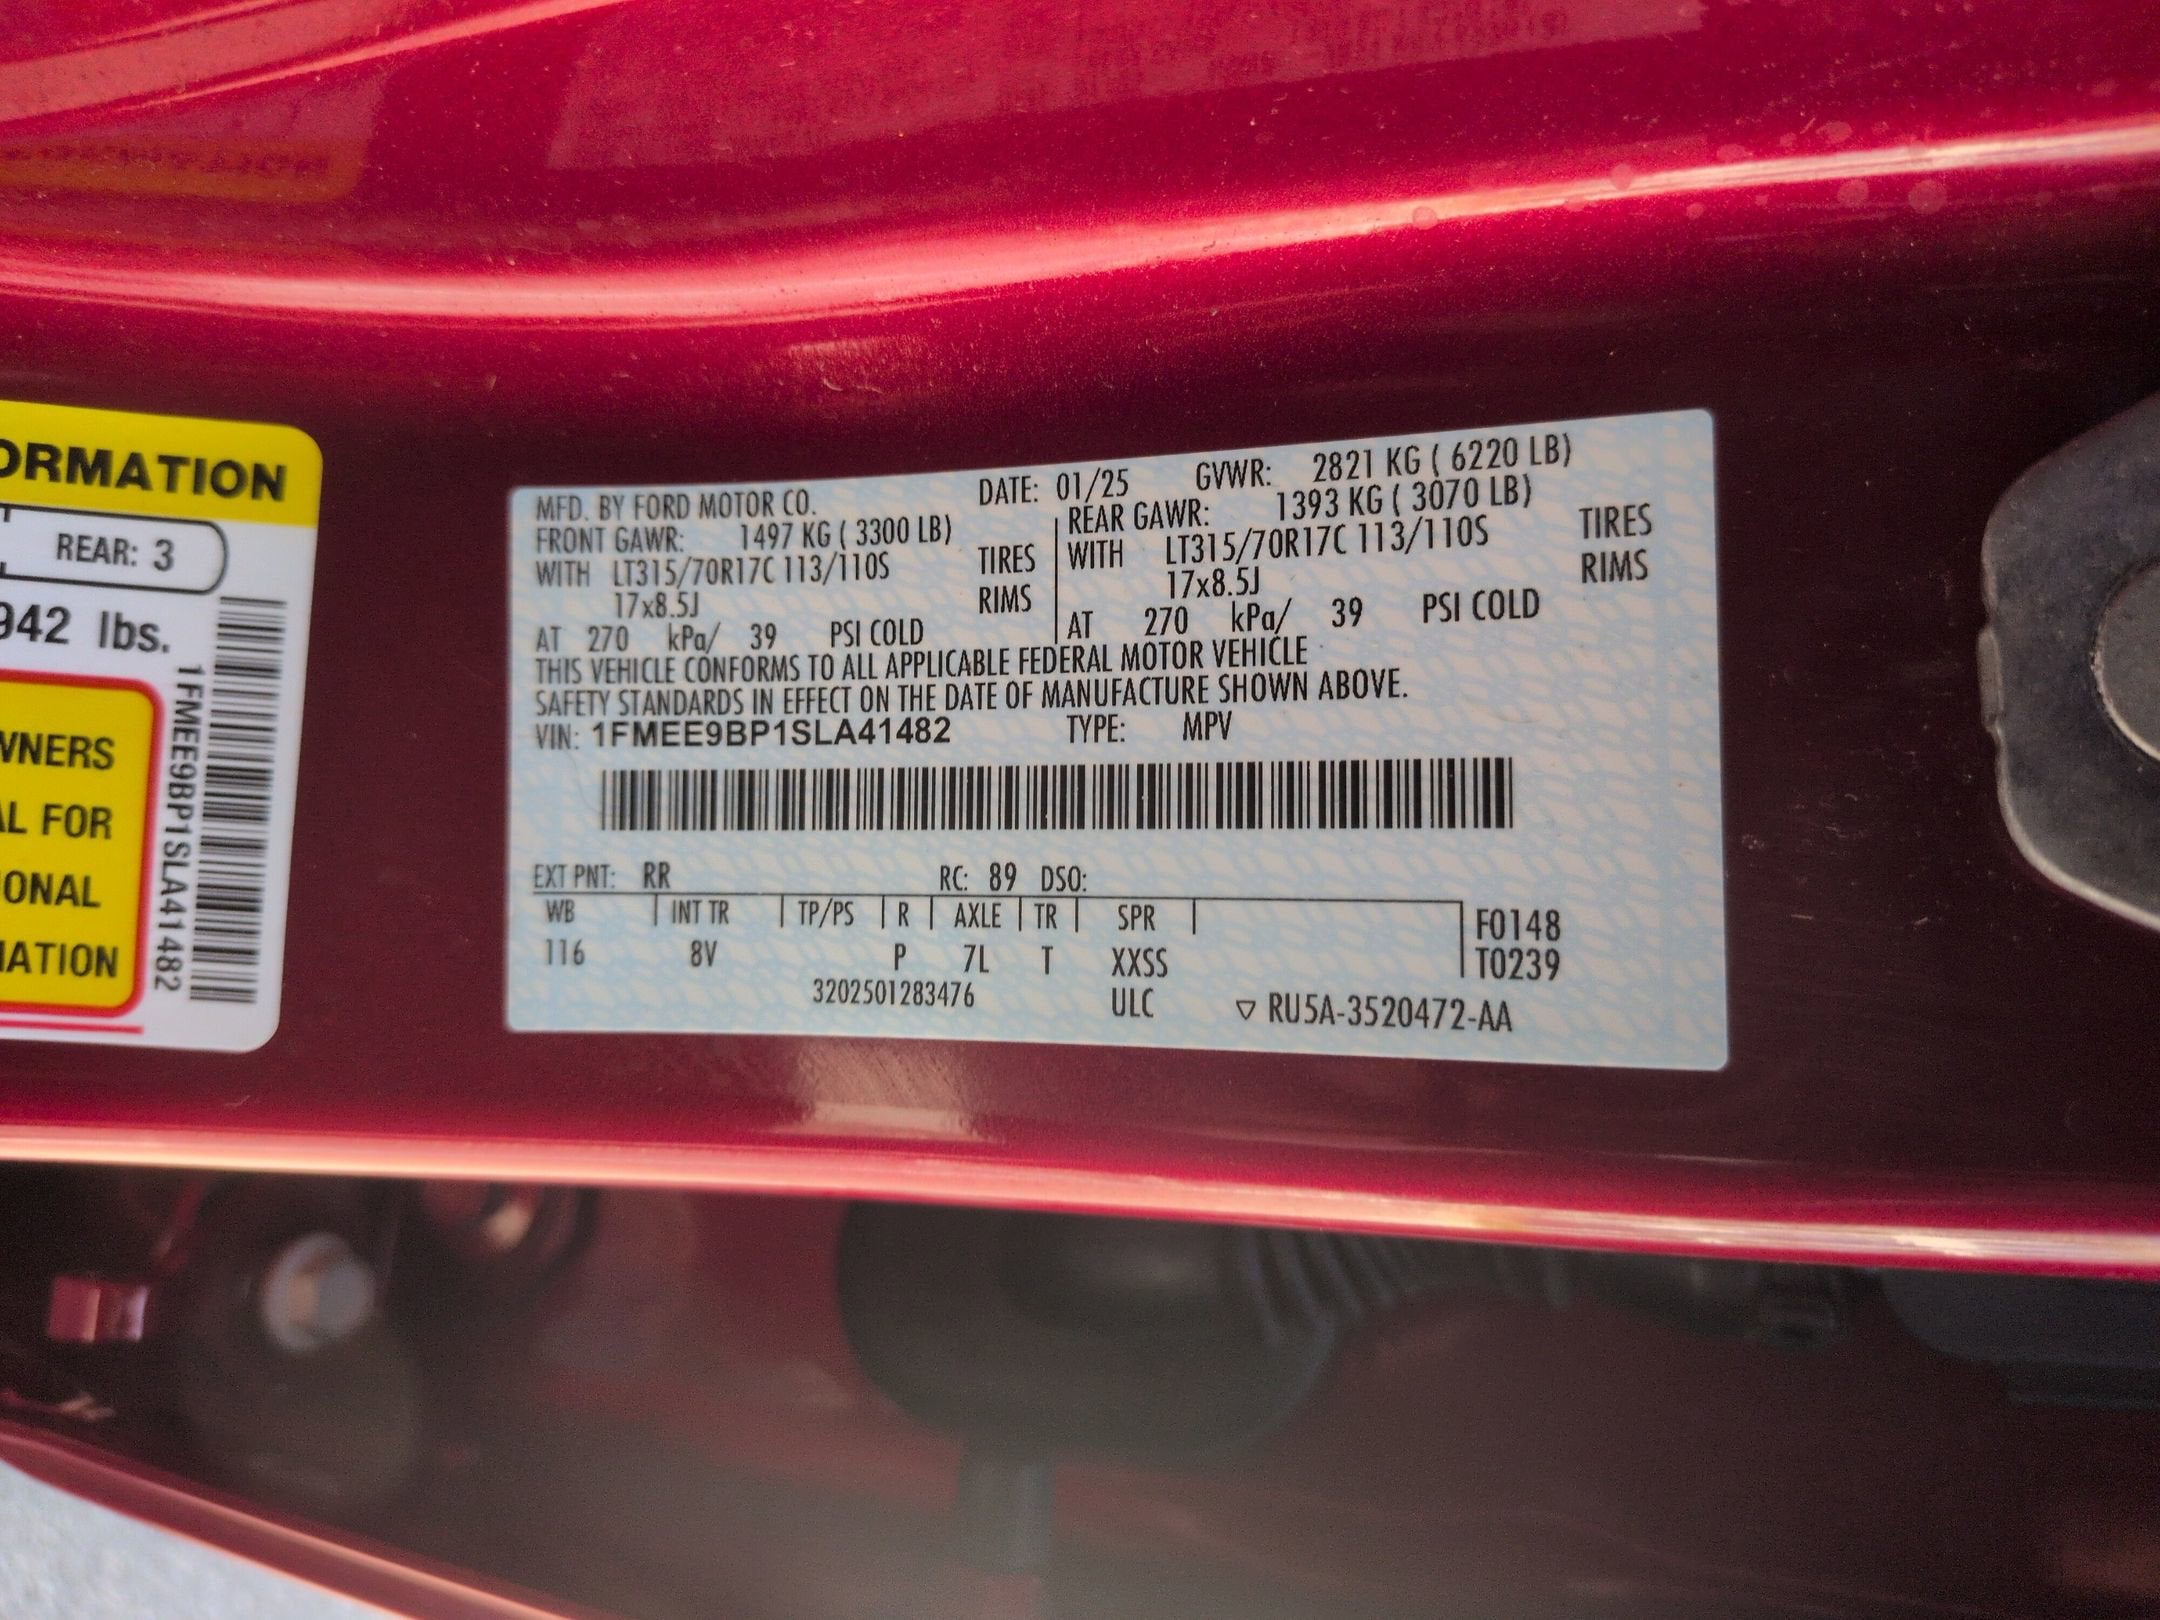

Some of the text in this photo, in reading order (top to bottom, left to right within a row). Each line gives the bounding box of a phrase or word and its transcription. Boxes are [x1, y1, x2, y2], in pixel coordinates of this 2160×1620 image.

[1196, 458, 1271, 491] GVWR:
[1313, 449, 1371, 482] 2821
[1387, 445, 1420, 477] KG
[1452, 437, 1518, 471] 6220
[1530, 433, 1571, 467] LB)
[980, 467, 1128, 506] DATE: 01/25
[536, 489, 816, 520] MFD. BY FORD MOTOR CO.
[1069, 504, 1124, 534] REAR
[1134, 498, 1208, 530] GAWR:
[1277, 488, 1338, 521] 1393
[1350, 484, 1382, 516] KG
[1412, 477, 1478, 511] 3070
[1491, 473, 1531, 508] LB)
[537, 527, 603, 553] FRONT
[615, 526, 683, 552] GAWR:
[741, 523, 793, 550] 1497
[803, 520, 830, 548] KG
[857, 516, 909, 546] 3300
[919, 514, 951, 545] LB)
[1579, 503, 1652, 539] TIRES
[57, 533, 174, 571] REAR: 3
[1067, 514, 1488, 570] WITH LT315/70R17C 113/110S
[536, 551, 889, 589] WITH LT315/70R17C 113/110S
[978, 543, 1035, 574] TIRES
[1582, 549, 1648, 583] RIMS
[1168, 566, 1259, 599] 17x8.5J
[616, 592, 698, 618] 17x8.5J
[979, 584, 1031, 614] RIMS
[1067, 588, 1539, 639] AT 270 kPa/ 39 PSI COLD
[99, 611, 170, 654] lbs.
[537, 618, 923, 654] AT 270 kPa/ 39 PSI COLD
[536, 636, 1307, 684] THIS VEHICLE CONFORMS TO ALL APPLICABLE FEDERAL MOTOR VEHICLE
[537, 668, 1407, 716] SAFETY STANDARDS IN EFFECT ON THE DATE OF MANUFACTURE SHOWN ABOVE.
[536, 716, 950, 749] VIN: 1FMEE9BP1SLA41482
[1066, 710, 1232, 743] TYPE: MPV
[43, 804, 112, 839] FOR
[154, 665, 205, 992] 1FMEE9BP1SLA41482
[535, 862, 670, 888] EXT PNT: RR
[940, 862, 1086, 892] RC: 89 DSO:
[547, 900, 573, 923] WB
[673, 900, 728, 924] INT TR
[798, 898, 854, 928] TP/PS
[899, 902, 908, 926] R
[954, 902, 1001, 928] AXLE
[1036, 903, 1057, 929] TR
[1118, 904, 1155, 931] SPR
[1477, 909, 1560, 941] F0148
[0, 941, 118, 978] ATION
[547, 940, 584, 965] 116
[691, 940, 717, 967] 8V
[895, 943, 906, 971] P
[964, 944, 989, 973] 7L
[1042, 946, 1053, 975] T
[1112, 947, 1167, 978] XXSS
[1475, 947, 1560, 981] T0239
[813, 979, 974, 1007] 3202501283476
[1112, 988, 1153, 1017] ULC
[1269, 992, 1512, 1032] RU5A-3520472-AA
